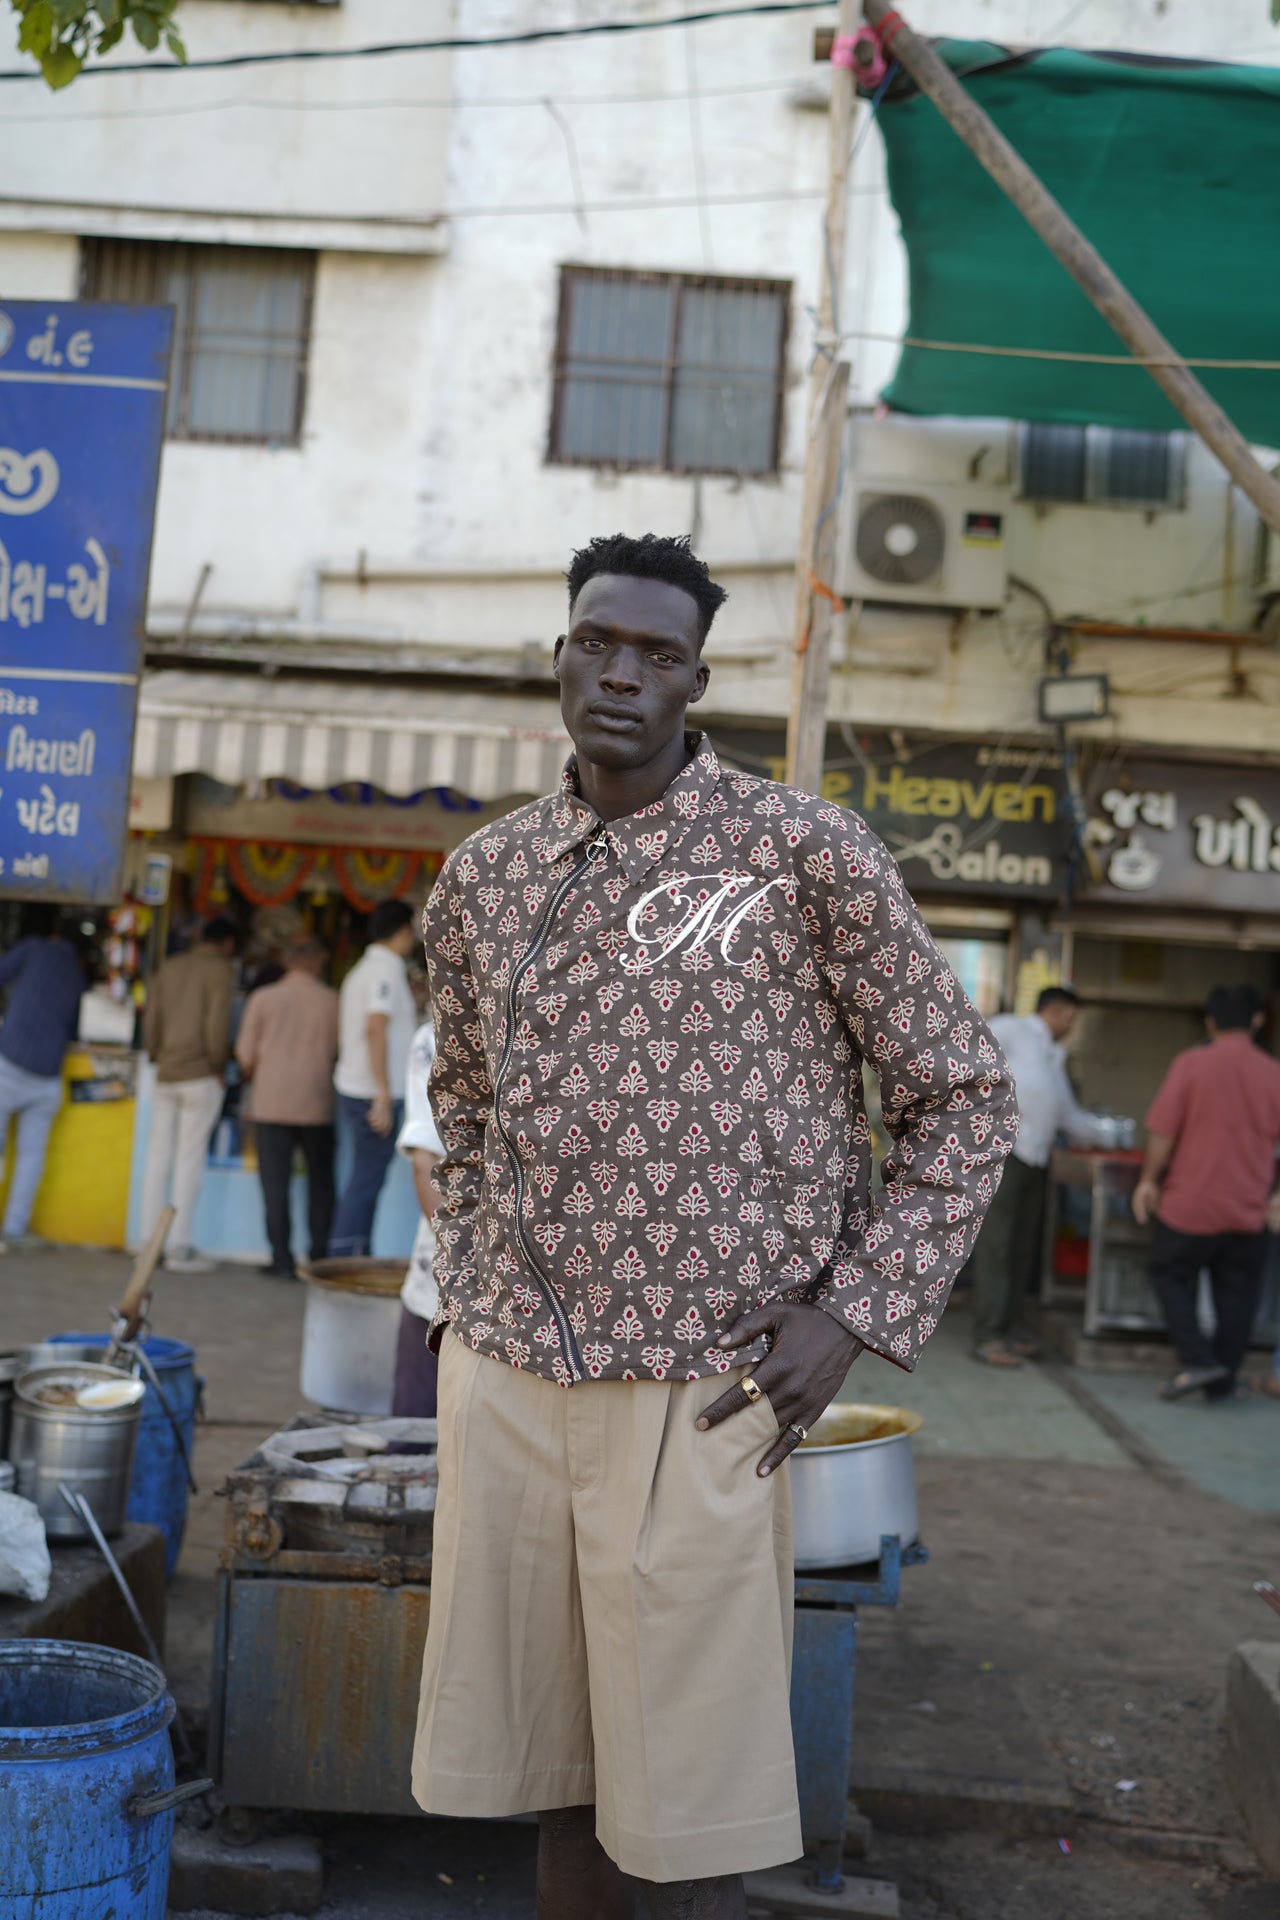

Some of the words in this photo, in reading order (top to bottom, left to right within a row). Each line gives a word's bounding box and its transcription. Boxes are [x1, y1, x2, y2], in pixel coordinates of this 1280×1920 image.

[16, 784, 80, 837] પટેલ
[763, 756, 851, 806] Te
[863, 762, 1056, 823] Heaven
